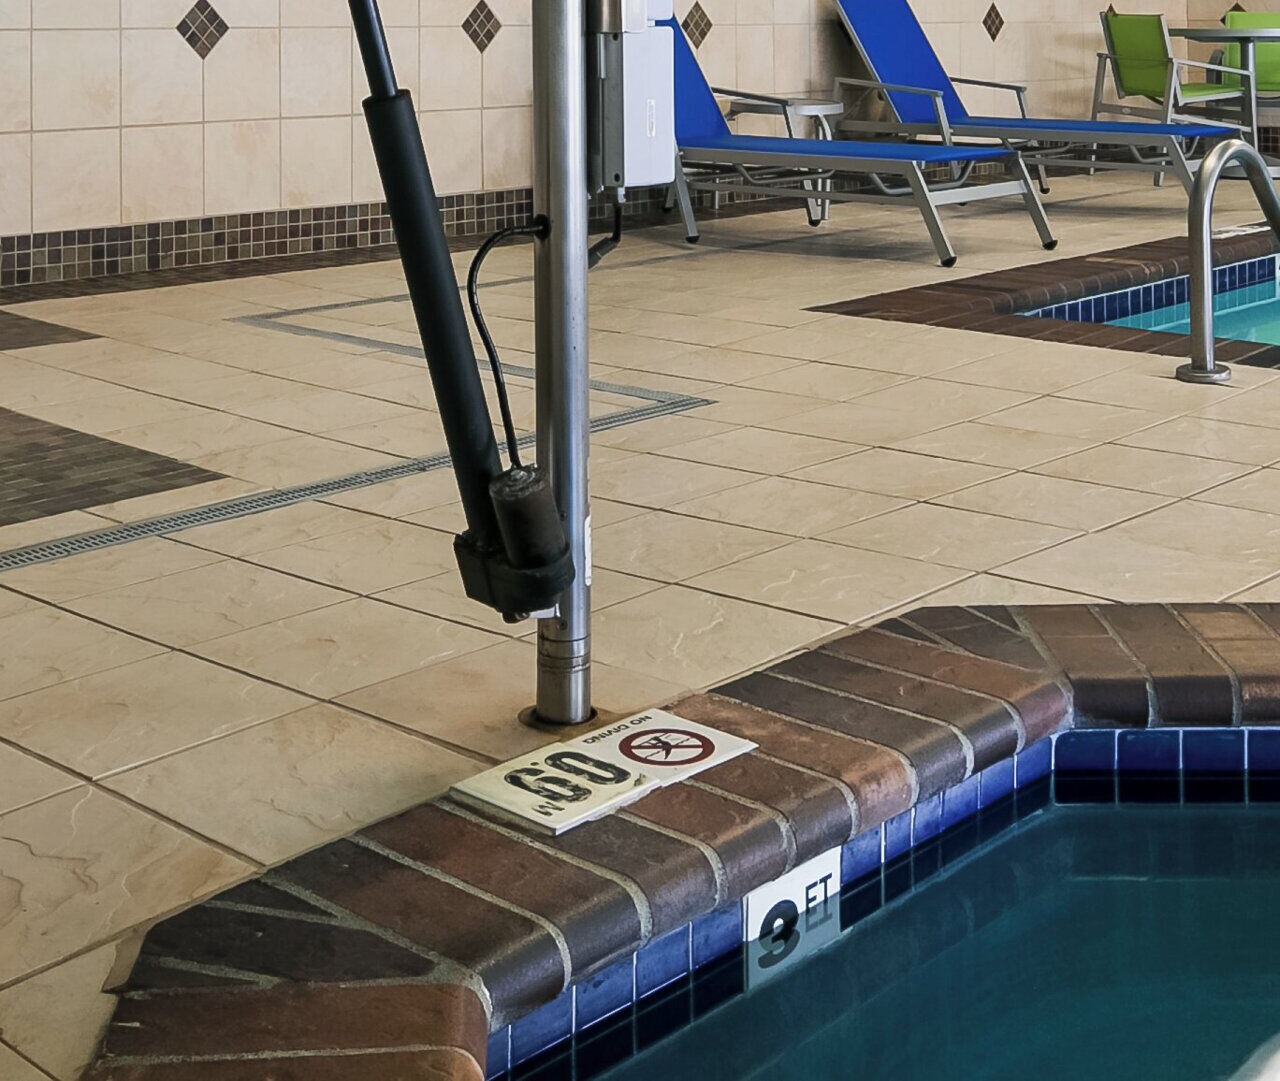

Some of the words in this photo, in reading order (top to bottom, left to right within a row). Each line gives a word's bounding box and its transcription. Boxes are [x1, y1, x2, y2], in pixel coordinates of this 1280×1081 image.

[632, 715, 653, 727] NO
[582, 724, 629, 744] DIVING
[806, 872, 833, 915] FT
